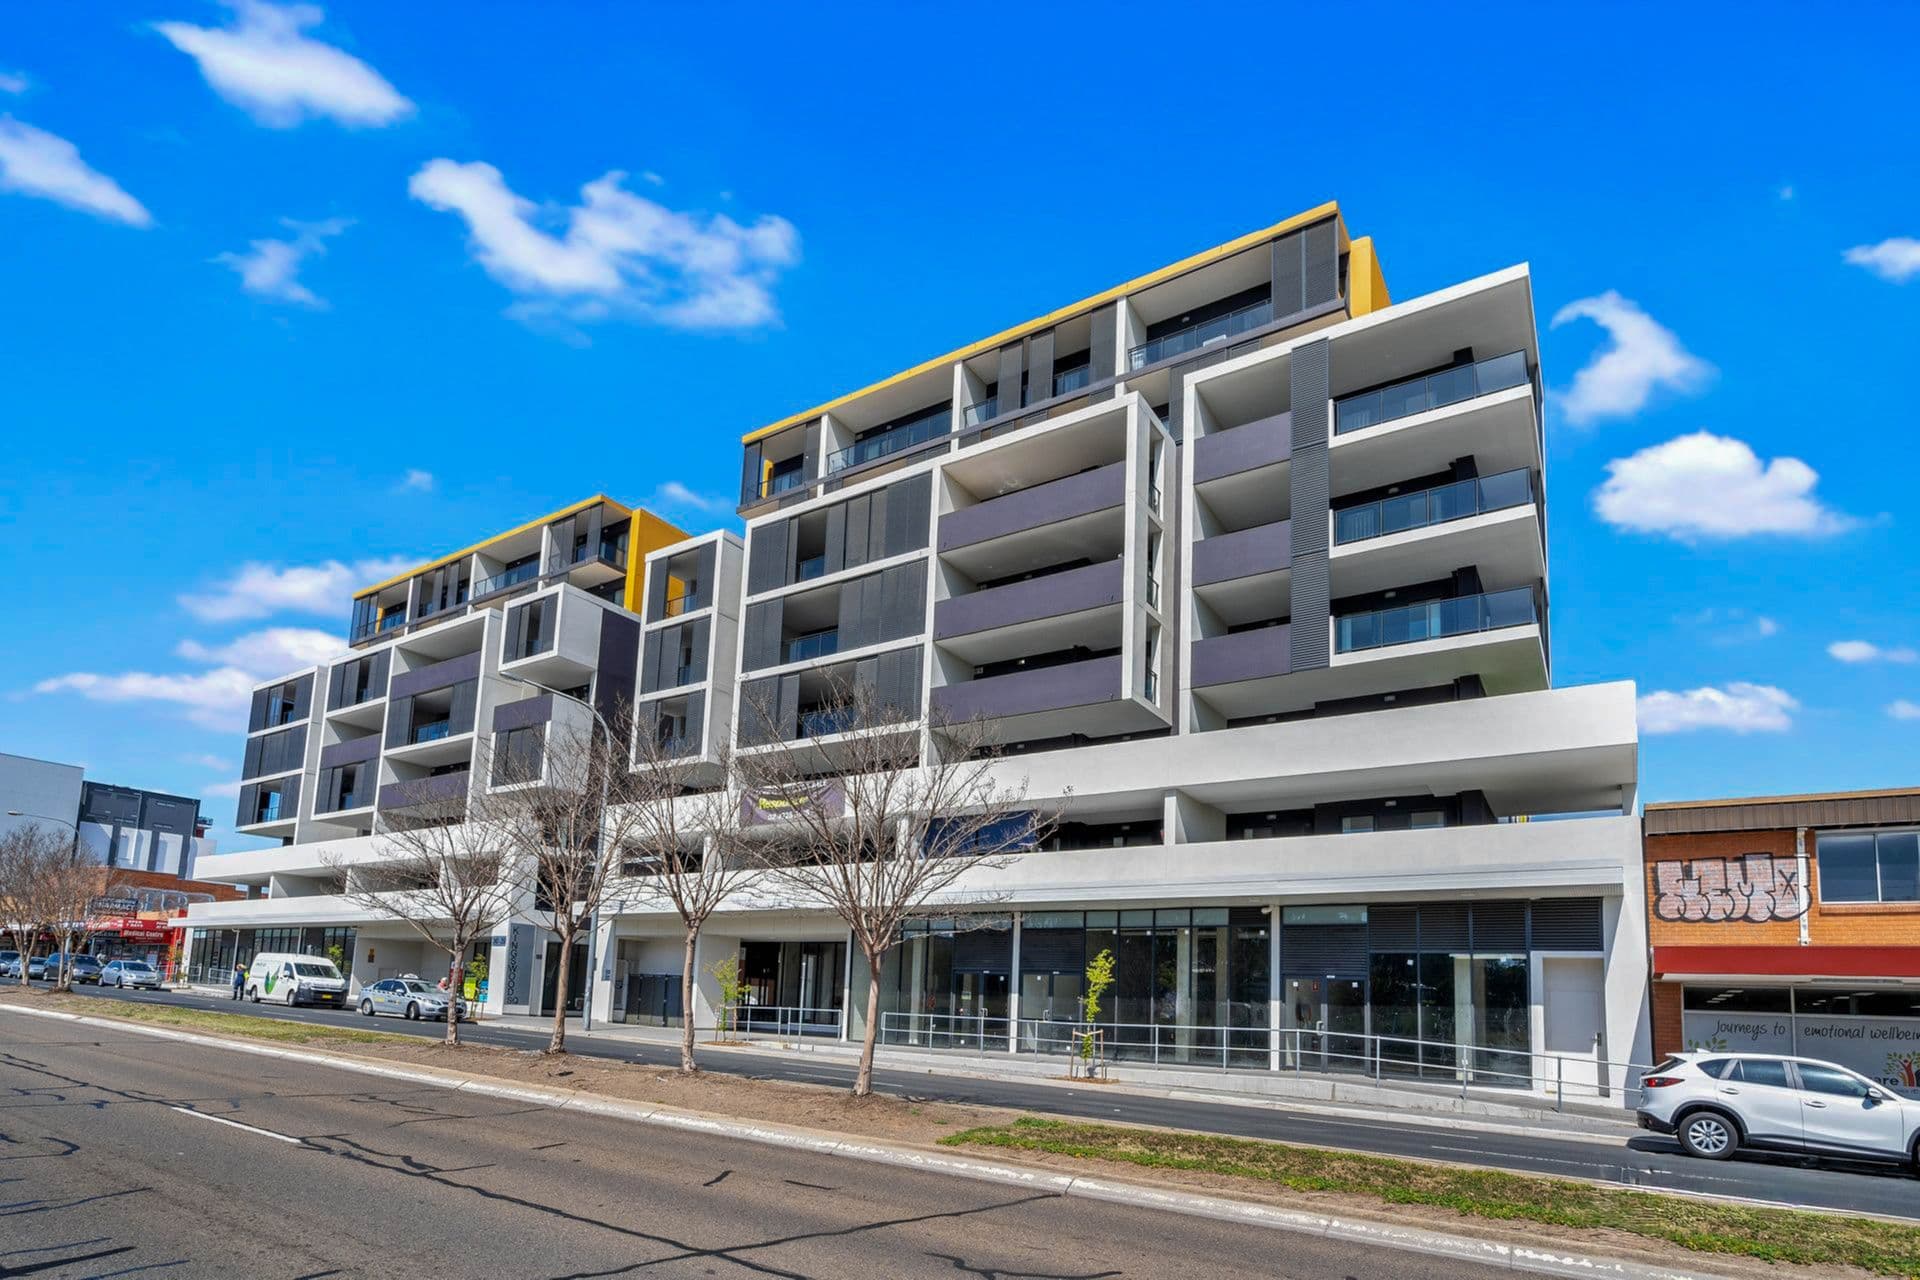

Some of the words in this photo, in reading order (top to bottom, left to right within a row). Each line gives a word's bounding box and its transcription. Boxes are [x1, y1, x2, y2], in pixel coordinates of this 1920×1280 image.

[124, 929, 145, 938] Medical
[507, 926, 519, 996] KINGSWOOD
[1715, 1019, 1767, 1041] Journeys
[1774, 1021, 1786, 1035] to
[1804, 1024, 1865, 1039] emotional
[1868, 1075, 1898, 1087] are
